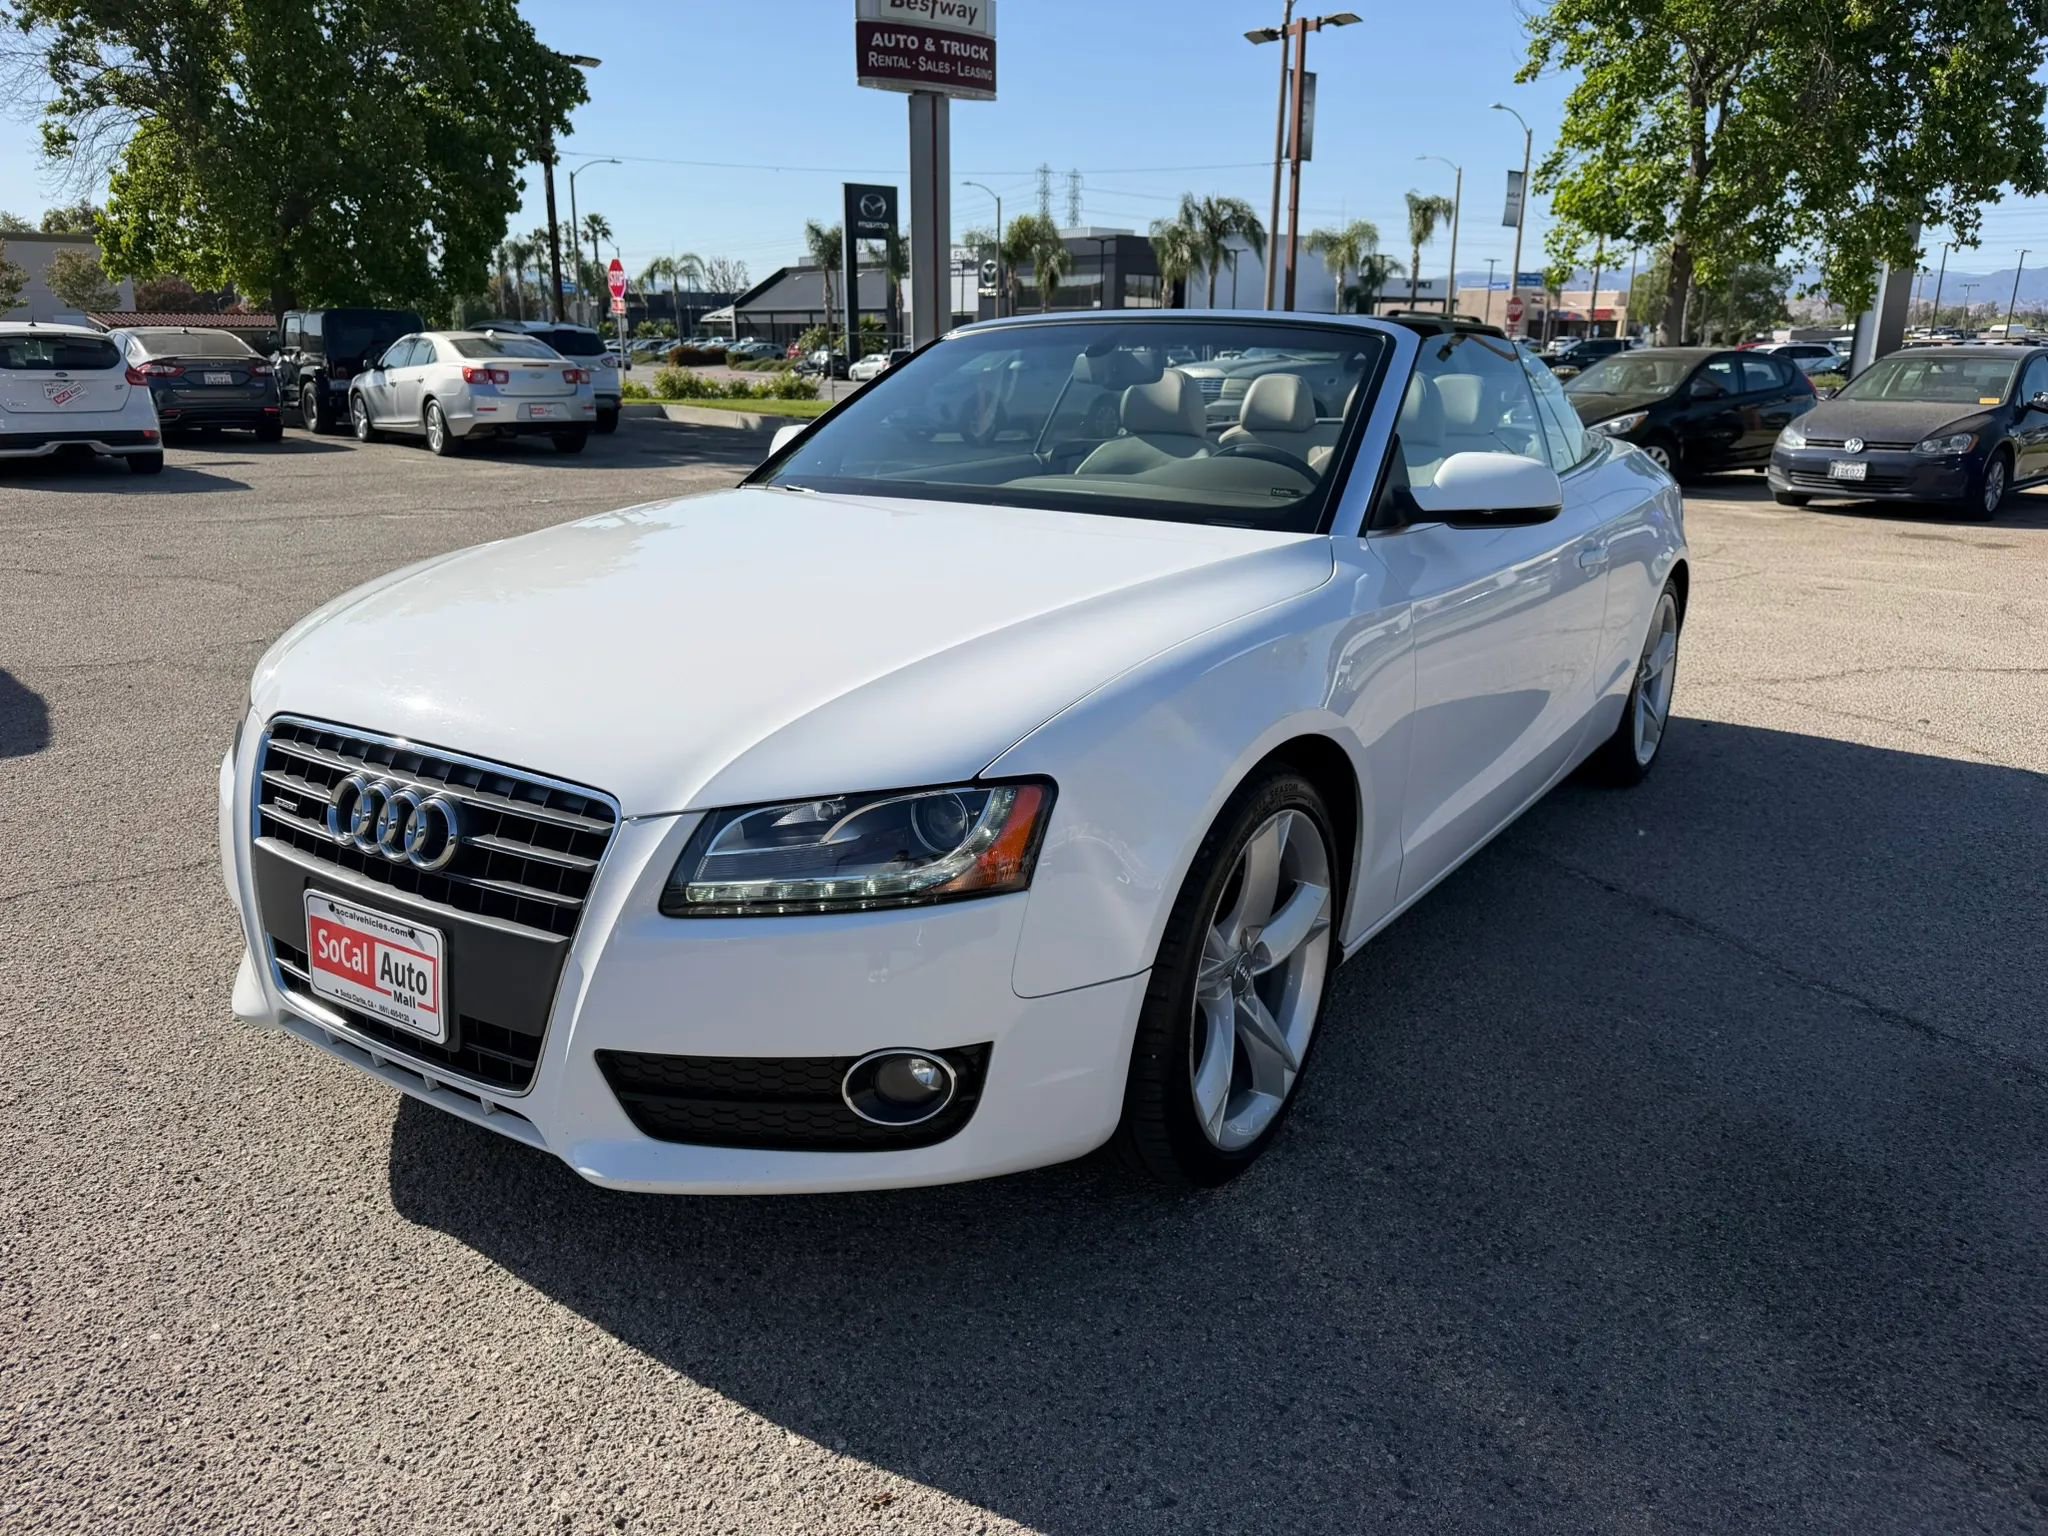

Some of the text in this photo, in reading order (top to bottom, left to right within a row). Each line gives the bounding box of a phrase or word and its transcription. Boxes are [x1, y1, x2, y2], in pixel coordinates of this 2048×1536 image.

[871, 32, 989, 61] AUTO & TRUCK
[609, 270, 624, 287] STOP
[335, 907, 409, 938] socalvehicles.com
[317, 928, 428, 996] SoCal Auto
[393, 990, 416, 1009] Mall
